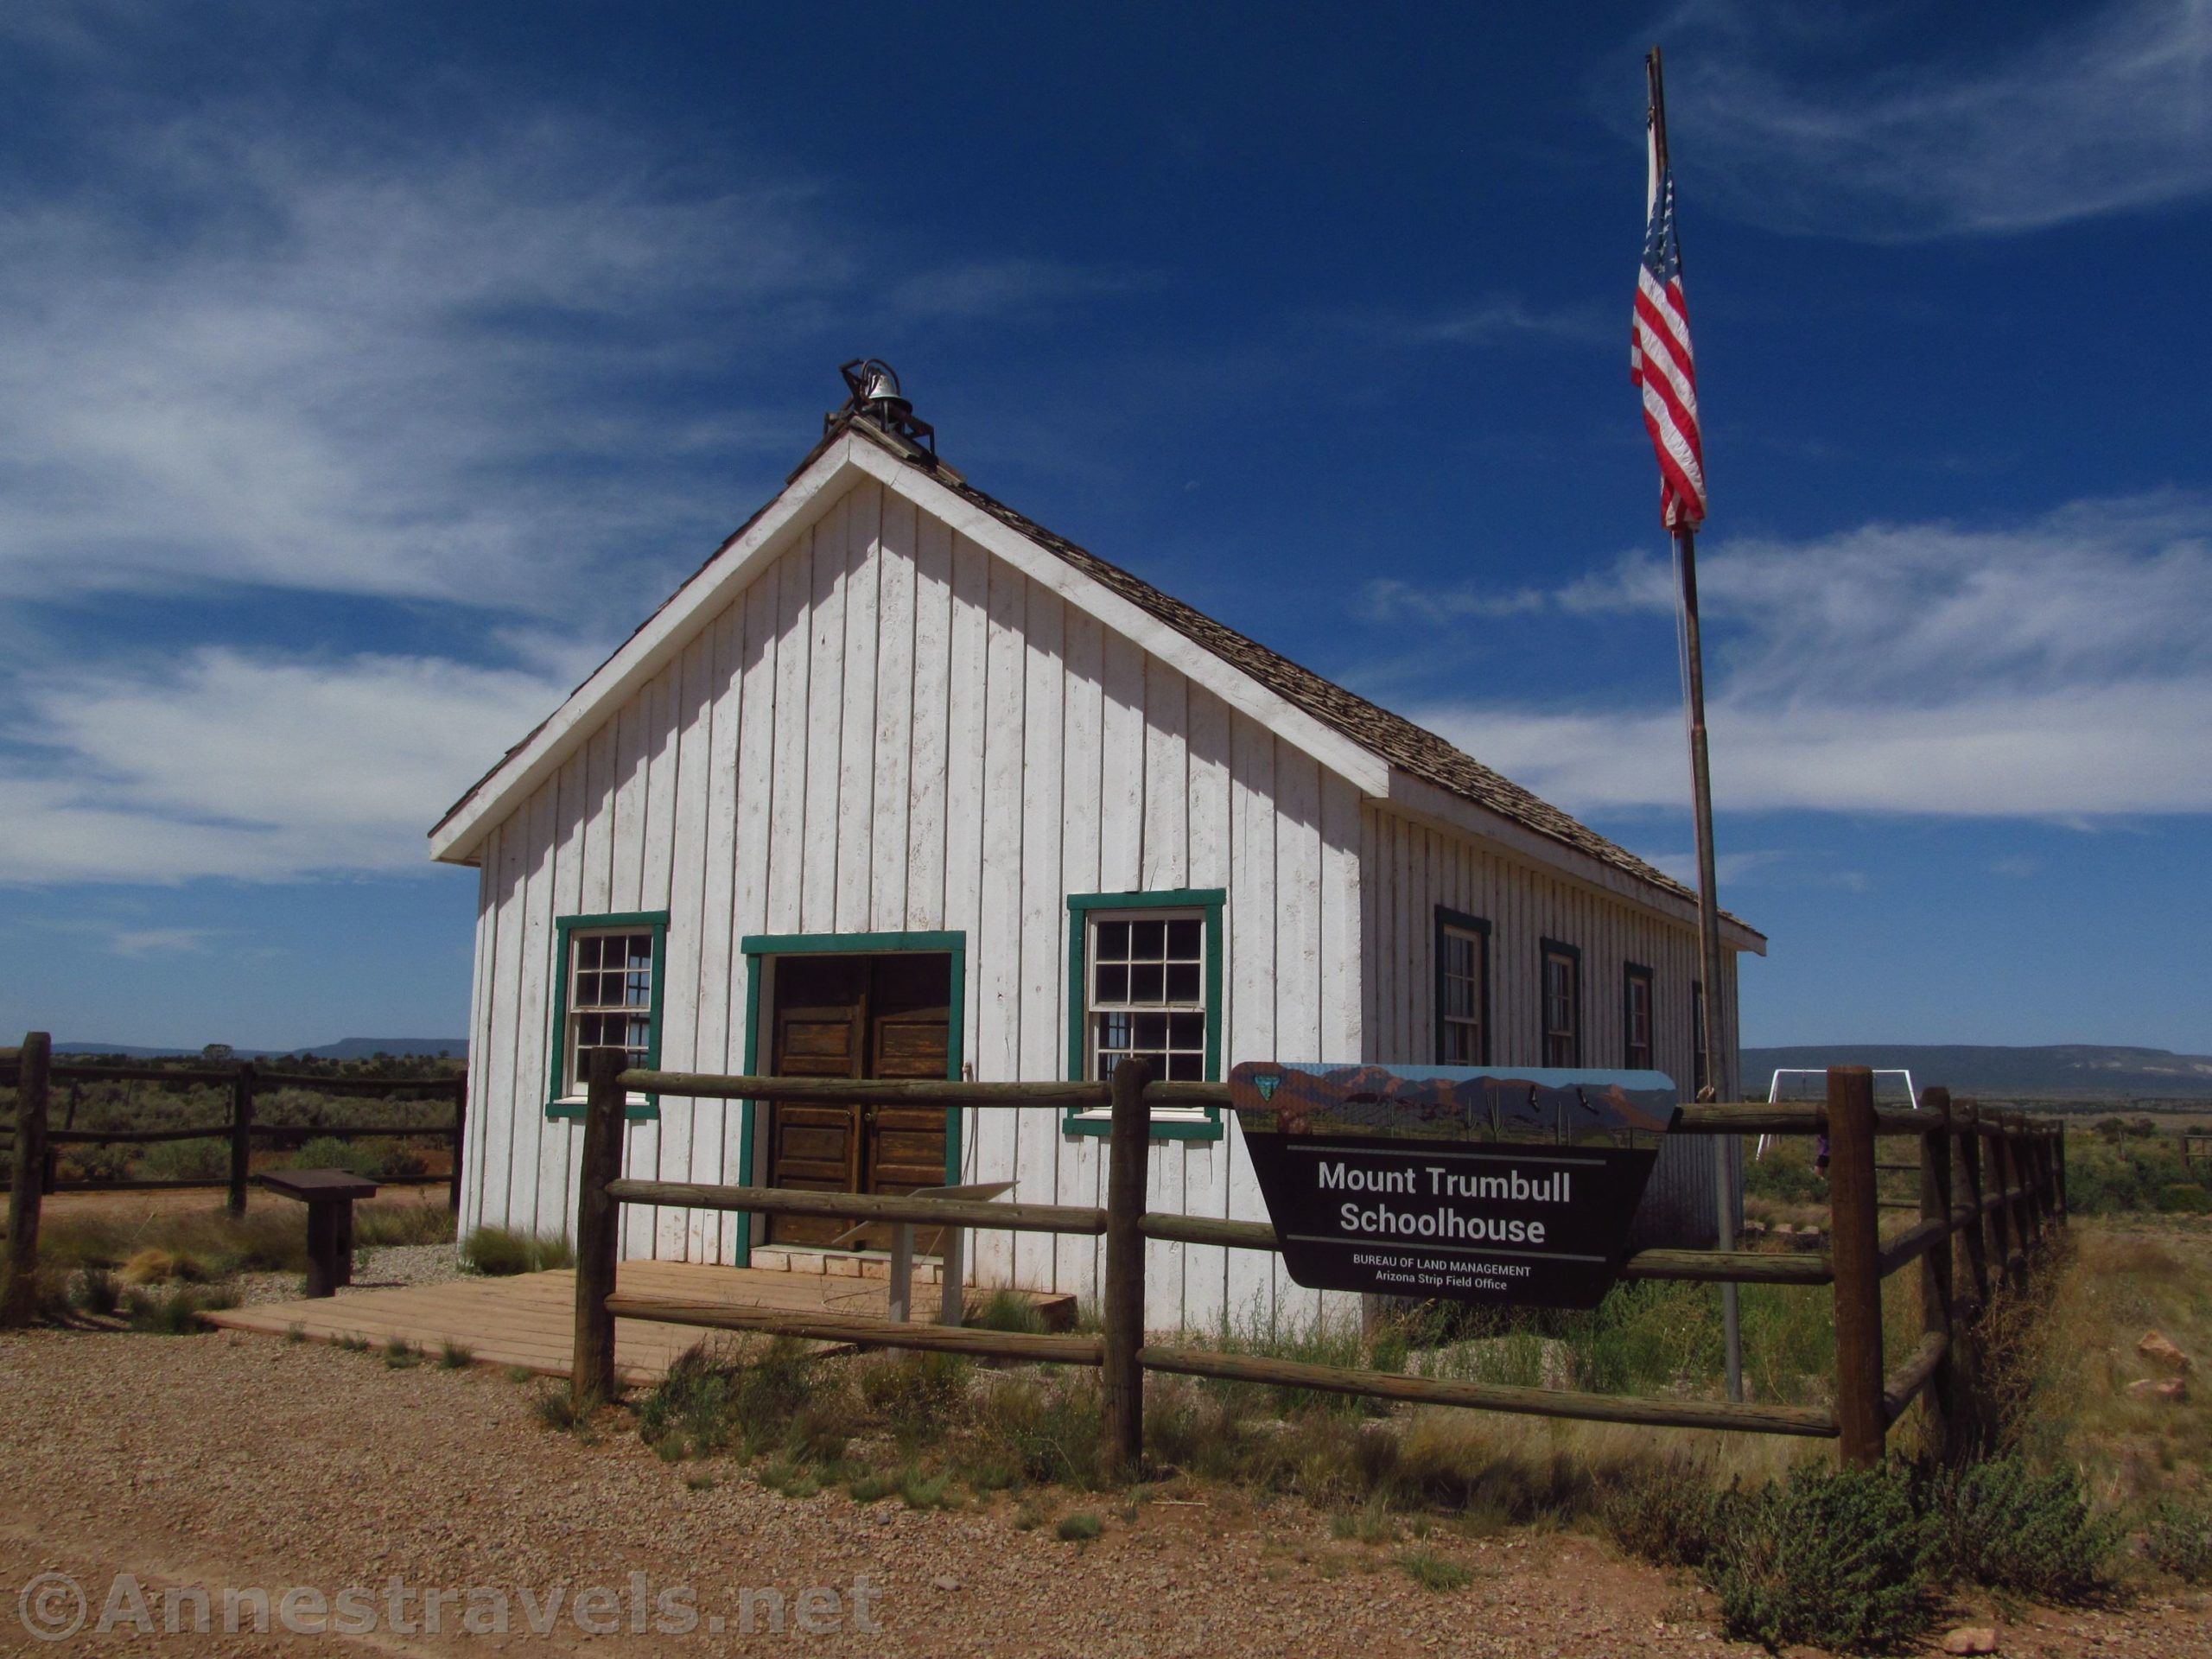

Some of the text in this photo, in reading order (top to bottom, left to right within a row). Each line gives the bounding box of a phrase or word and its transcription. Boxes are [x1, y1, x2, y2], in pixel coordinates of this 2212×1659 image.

[1318, 1161, 1571, 1203] Mount Trumbull
[1339, 1203, 1546, 1244] Schoolhouse
[1353, 1254, 1531, 1277] BUREAU OF LAND MANAGEMENT
[1376, 1269, 1507, 1290] Arizona Strip Field Office
